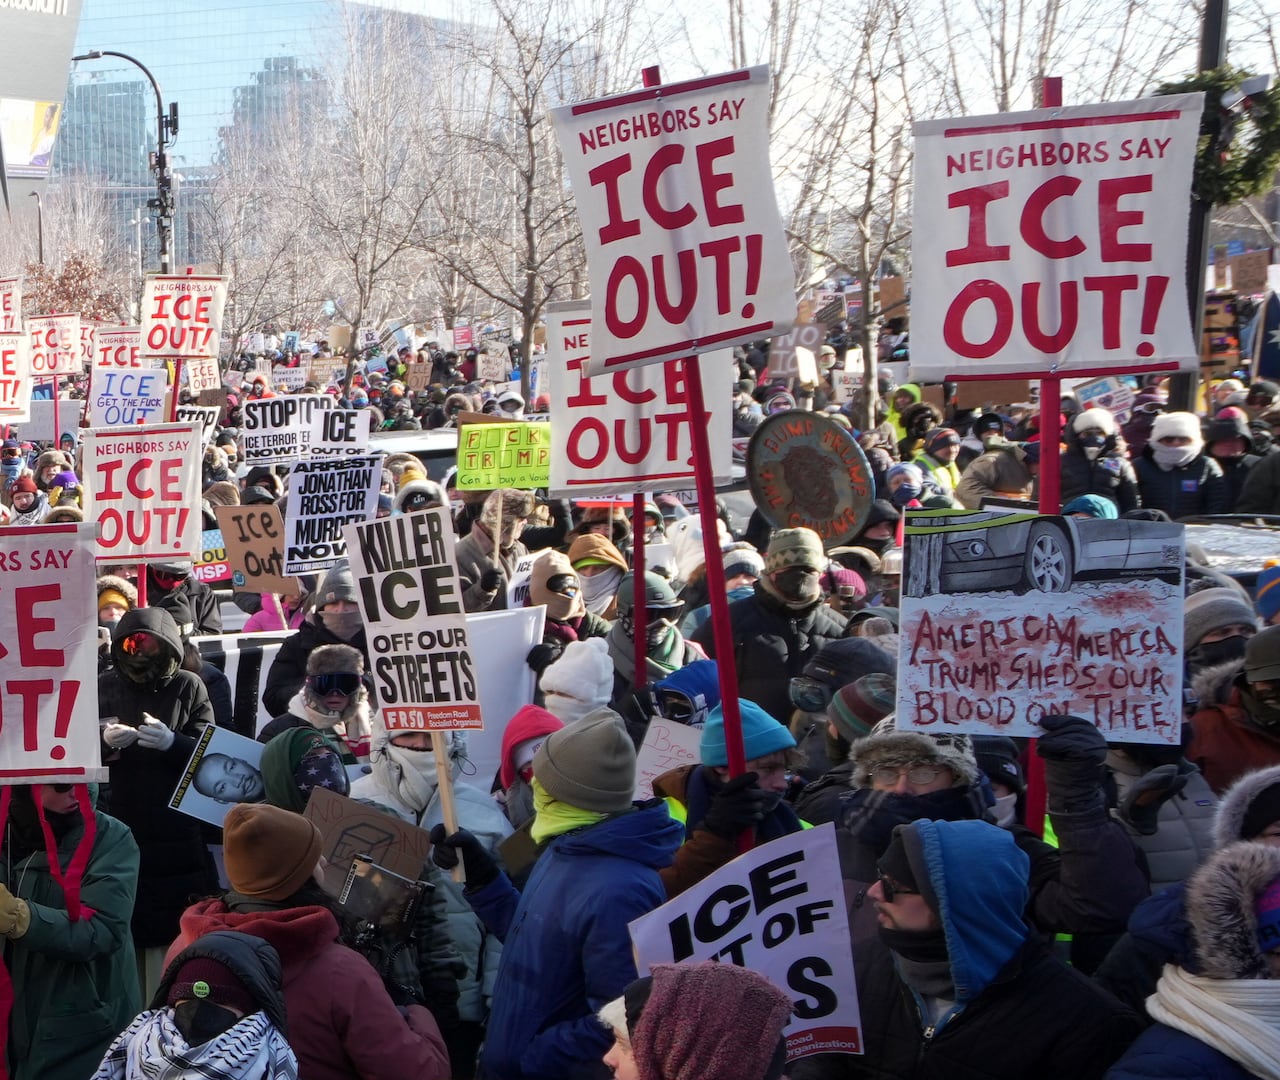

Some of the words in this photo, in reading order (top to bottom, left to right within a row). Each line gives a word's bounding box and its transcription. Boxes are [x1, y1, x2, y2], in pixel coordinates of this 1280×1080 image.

[580, 107, 706, 159] NEIGHBORS
[707, 97, 746, 125] SAY
[948, 142, 1108, 176] NEIGHBORS
[1118, 136, 1172, 162] SAY
[589, 126, 744, 244] ICE
[946, 174, 1152, 267] ICE
[154, 283, 201, 292] NEIGHBORS
[606, 234, 774, 346] OUT!
[151, 294, 213, 324] ICE
[944, 275, 1168, 359] OUT!
[147, 323, 214, 352] OUT!
[32, 352, 76, 372] OUT!
[192, 365, 214, 377] ICE
[101, 374, 155, 396] ICE
[97, 398, 118, 408] GET
[122, 399, 139, 407] THE
[141, 397, 162, 407] FUCK
[105, 406, 156, 425] OUT
[245, 400, 297, 429] STOP
[245, 436, 259, 448] ICE
[261, 433, 297, 447] TERROR
[323, 411, 358, 441] ICE
[96, 442, 162, 455] NEIGHBORS
[164, 440, 190, 452] SAY
[95, 457, 183, 502] ICE
[293, 456, 380, 473] ARREST
[298, 470, 372, 495] JONATHAN
[300, 493, 337, 516] ROSS
[339, 490, 366, 511] FOR
[96, 507, 190, 549] OUT!
[357, 511, 446, 574] KILLER
[31, 550, 73, 570] SAY
[359, 559, 460, 622] ICE
[373, 633, 414, 653] OFF
[417, 628, 467, 649] OUR
[909, 610, 1060, 665] AMERICA
[1056, 616, 1178, 662] AMERICA
[375, 651, 477, 704] STREETS
[921, 659, 1000, 692] TRUMP
[1006, 652, 1097, 690] SHEDS
[1108, 666, 1169, 695] OUR
[387, 711, 424, 728] FRSO
[427, 711, 452, 720] Freedom
[453, 710, 468, 719] Road
[913, 690, 1016, 726] BLOOD
[1085, 693, 1172, 730] THEE
[668, 850, 809, 963] ICE
[762, 900, 834, 949] OF
